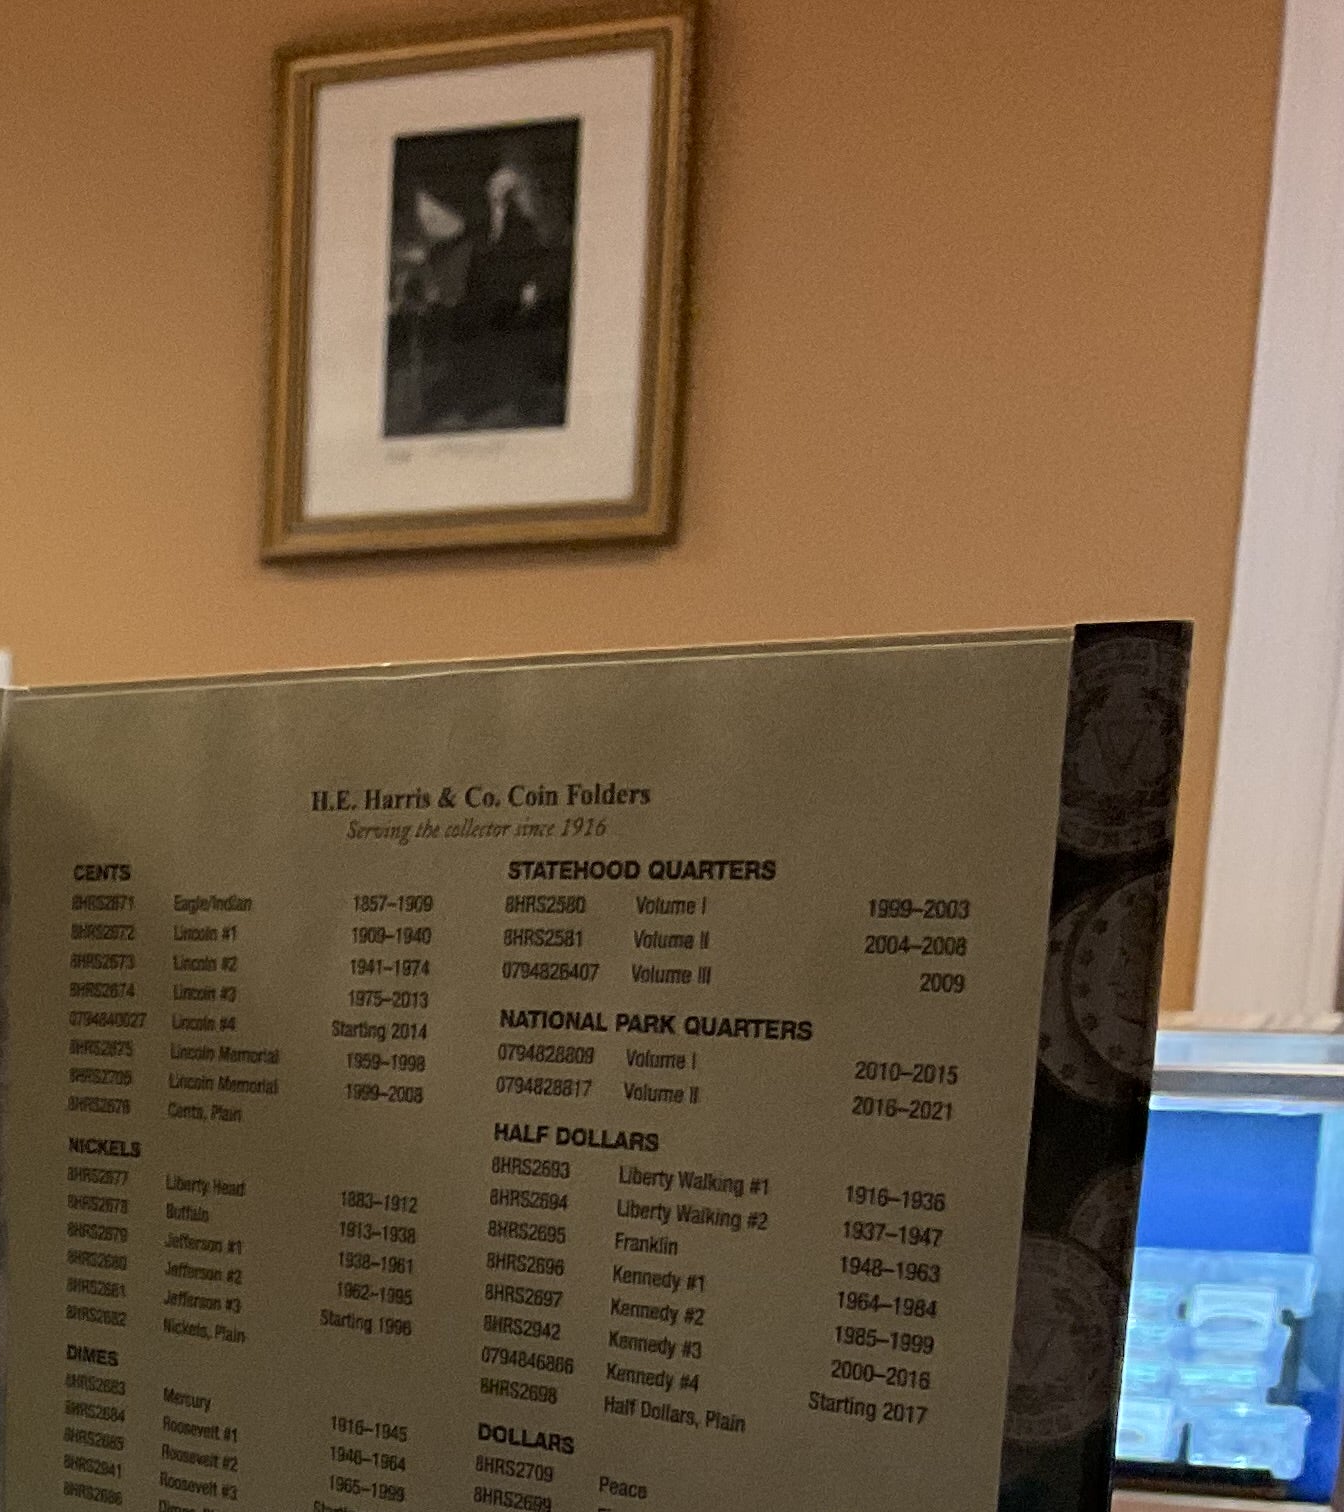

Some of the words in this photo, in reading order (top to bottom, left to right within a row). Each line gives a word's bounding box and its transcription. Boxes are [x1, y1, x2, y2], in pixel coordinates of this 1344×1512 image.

[312, 789, 357, 811] H.E.
[364, 788, 430, 810] Harris
[438, 787, 456, 809] &
[464, 785, 501, 808] Co.
[508, 785, 559, 808] Coin
[567, 784, 651, 806] Folders
[347, 820, 410, 844] Serving
[416, 820, 441, 839] the
[444, 819, 510, 838] collector
[516, 819, 555, 838] since
[560, 818, 606, 838] 1916
[74, 864, 131, 881] CENTS
[508, 860, 640, 881] STATEHOOD
[648, 860, 776, 881] QUARTERS
[636, 897, 697, 915] Volume
[634, 931, 694, 950] Volume
[700, 931, 709, 950] II
[632, 965, 692, 984] Volume
[698, 965, 711, 985] III
[920, 973, 965, 994] 2009
[332, 1020, 386, 1041] Starting
[391, 1024, 427, 1040] 2014
[500, 1009, 607, 1033] NATIONAL
[616, 1013, 675, 1035] PARK
[685, 1016, 812, 1041] QUARTERS
[624, 1083, 684, 1104] Volume
[689, 1085, 699, 1105] II
[68, 1138, 141, 1158] NICKELS
[494, 1123, 548, 1144] HALF
[556, 1127, 658, 1152] DOLLARS
[619, 1166, 673, 1191] Liberty
[679, 1170, 744, 1198] Walking
[750, 1177, 769, 1196] #1
[617, 1199, 671, 1224] Liberty
[677, 1205, 741, 1231] Walking
[747, 1211, 768, 1230] #2
[614, 1233, 678, 1255] Franklin
[613, 1265, 680, 1292] Kennedy
[686, 1273, 706, 1291] #1
[67, 1344, 118, 1367] DIMES
[604, 1396, 636, 1416] Half
[641, 1401, 700, 1429] Dollars,
[706, 1410, 745, 1433] Plain
[809, 1392, 876, 1422] Starting
[882, 1403, 927, 1425] 2017
[478, 1423, 575, 1454] DOLLARS
[599, 1477, 647, 1499] Peace
